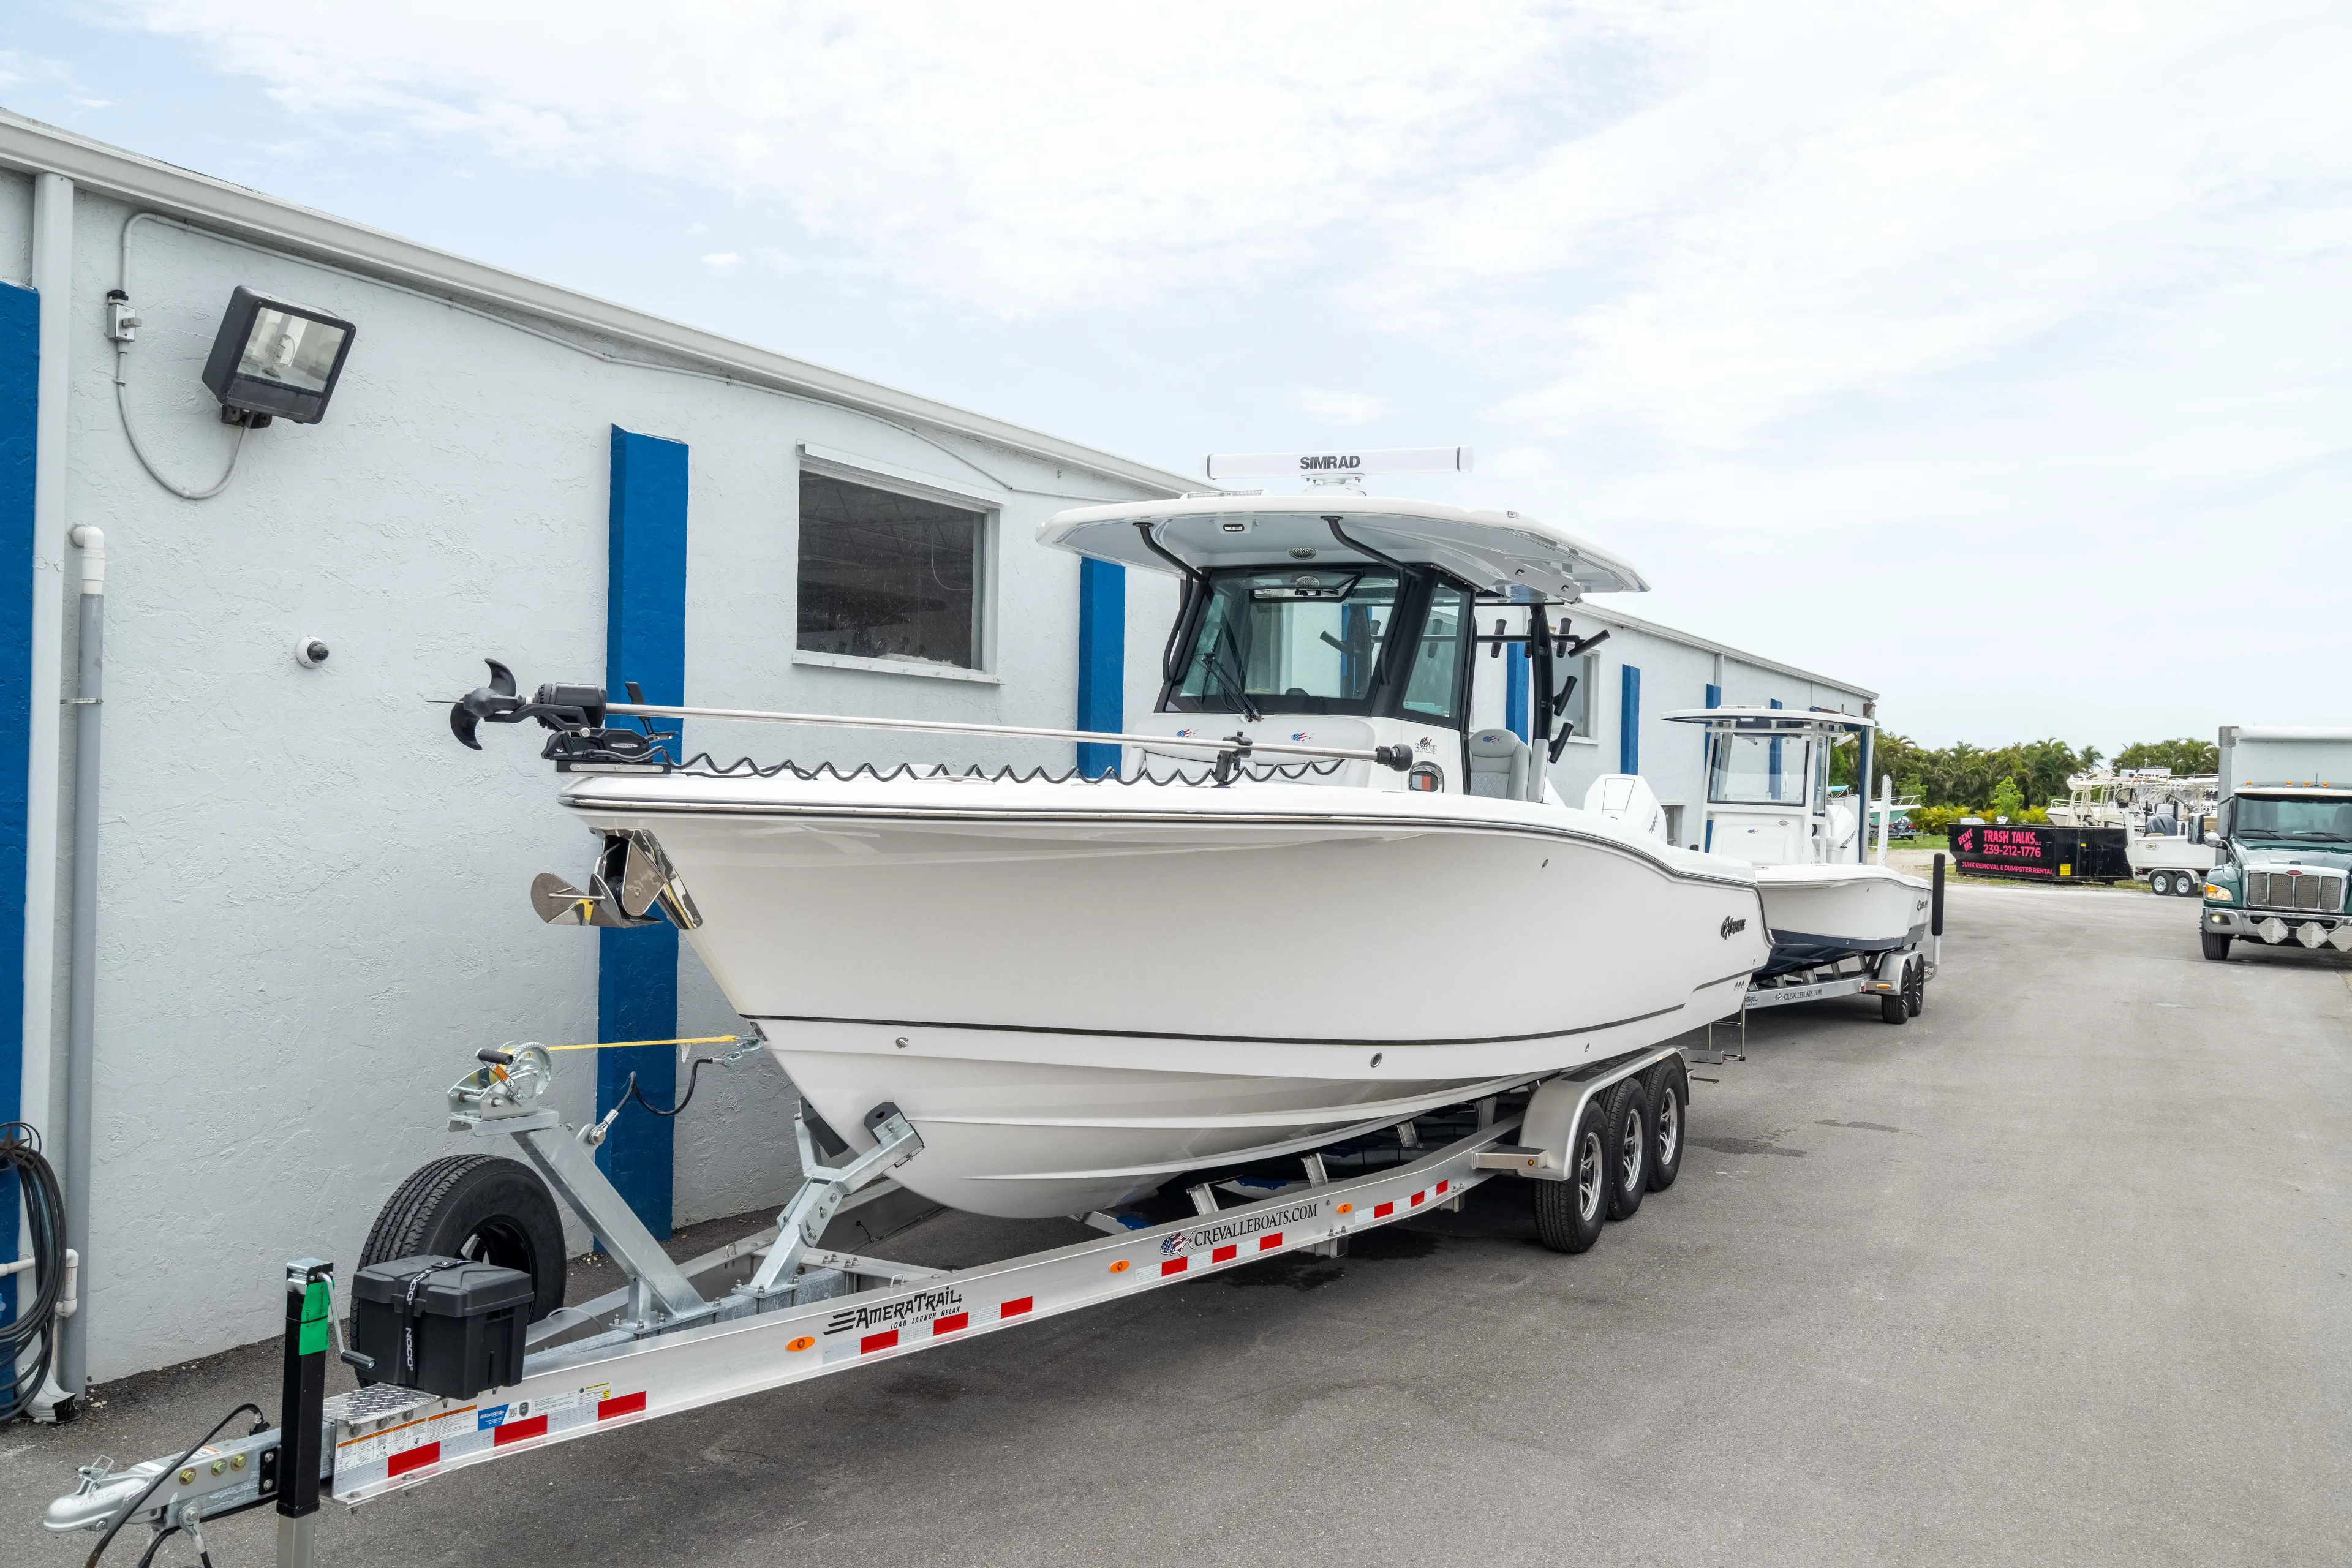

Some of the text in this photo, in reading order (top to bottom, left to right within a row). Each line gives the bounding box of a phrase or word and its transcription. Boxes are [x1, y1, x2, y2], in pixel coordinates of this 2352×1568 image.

[1300, 456, 1360, 470] SIMRAD
[1841, 830, 1856, 846] ERCURY
[1958, 828, 1973, 845] RENT
[1983, 829, 2009, 843] TRASH
[2011, 831, 2035, 845] TALKS
[1963, 840, 1973, 852] ME
[1983, 844, 2041, 858] 239-212-1776
[1784, 989, 1822, 1000] CREVALLEBOATS.COM
[1194, 1203, 1317, 1246] CREVALLEBOATS.COM
[891, 1306, 960, 1330] LOAD LAUNCH RELAX
